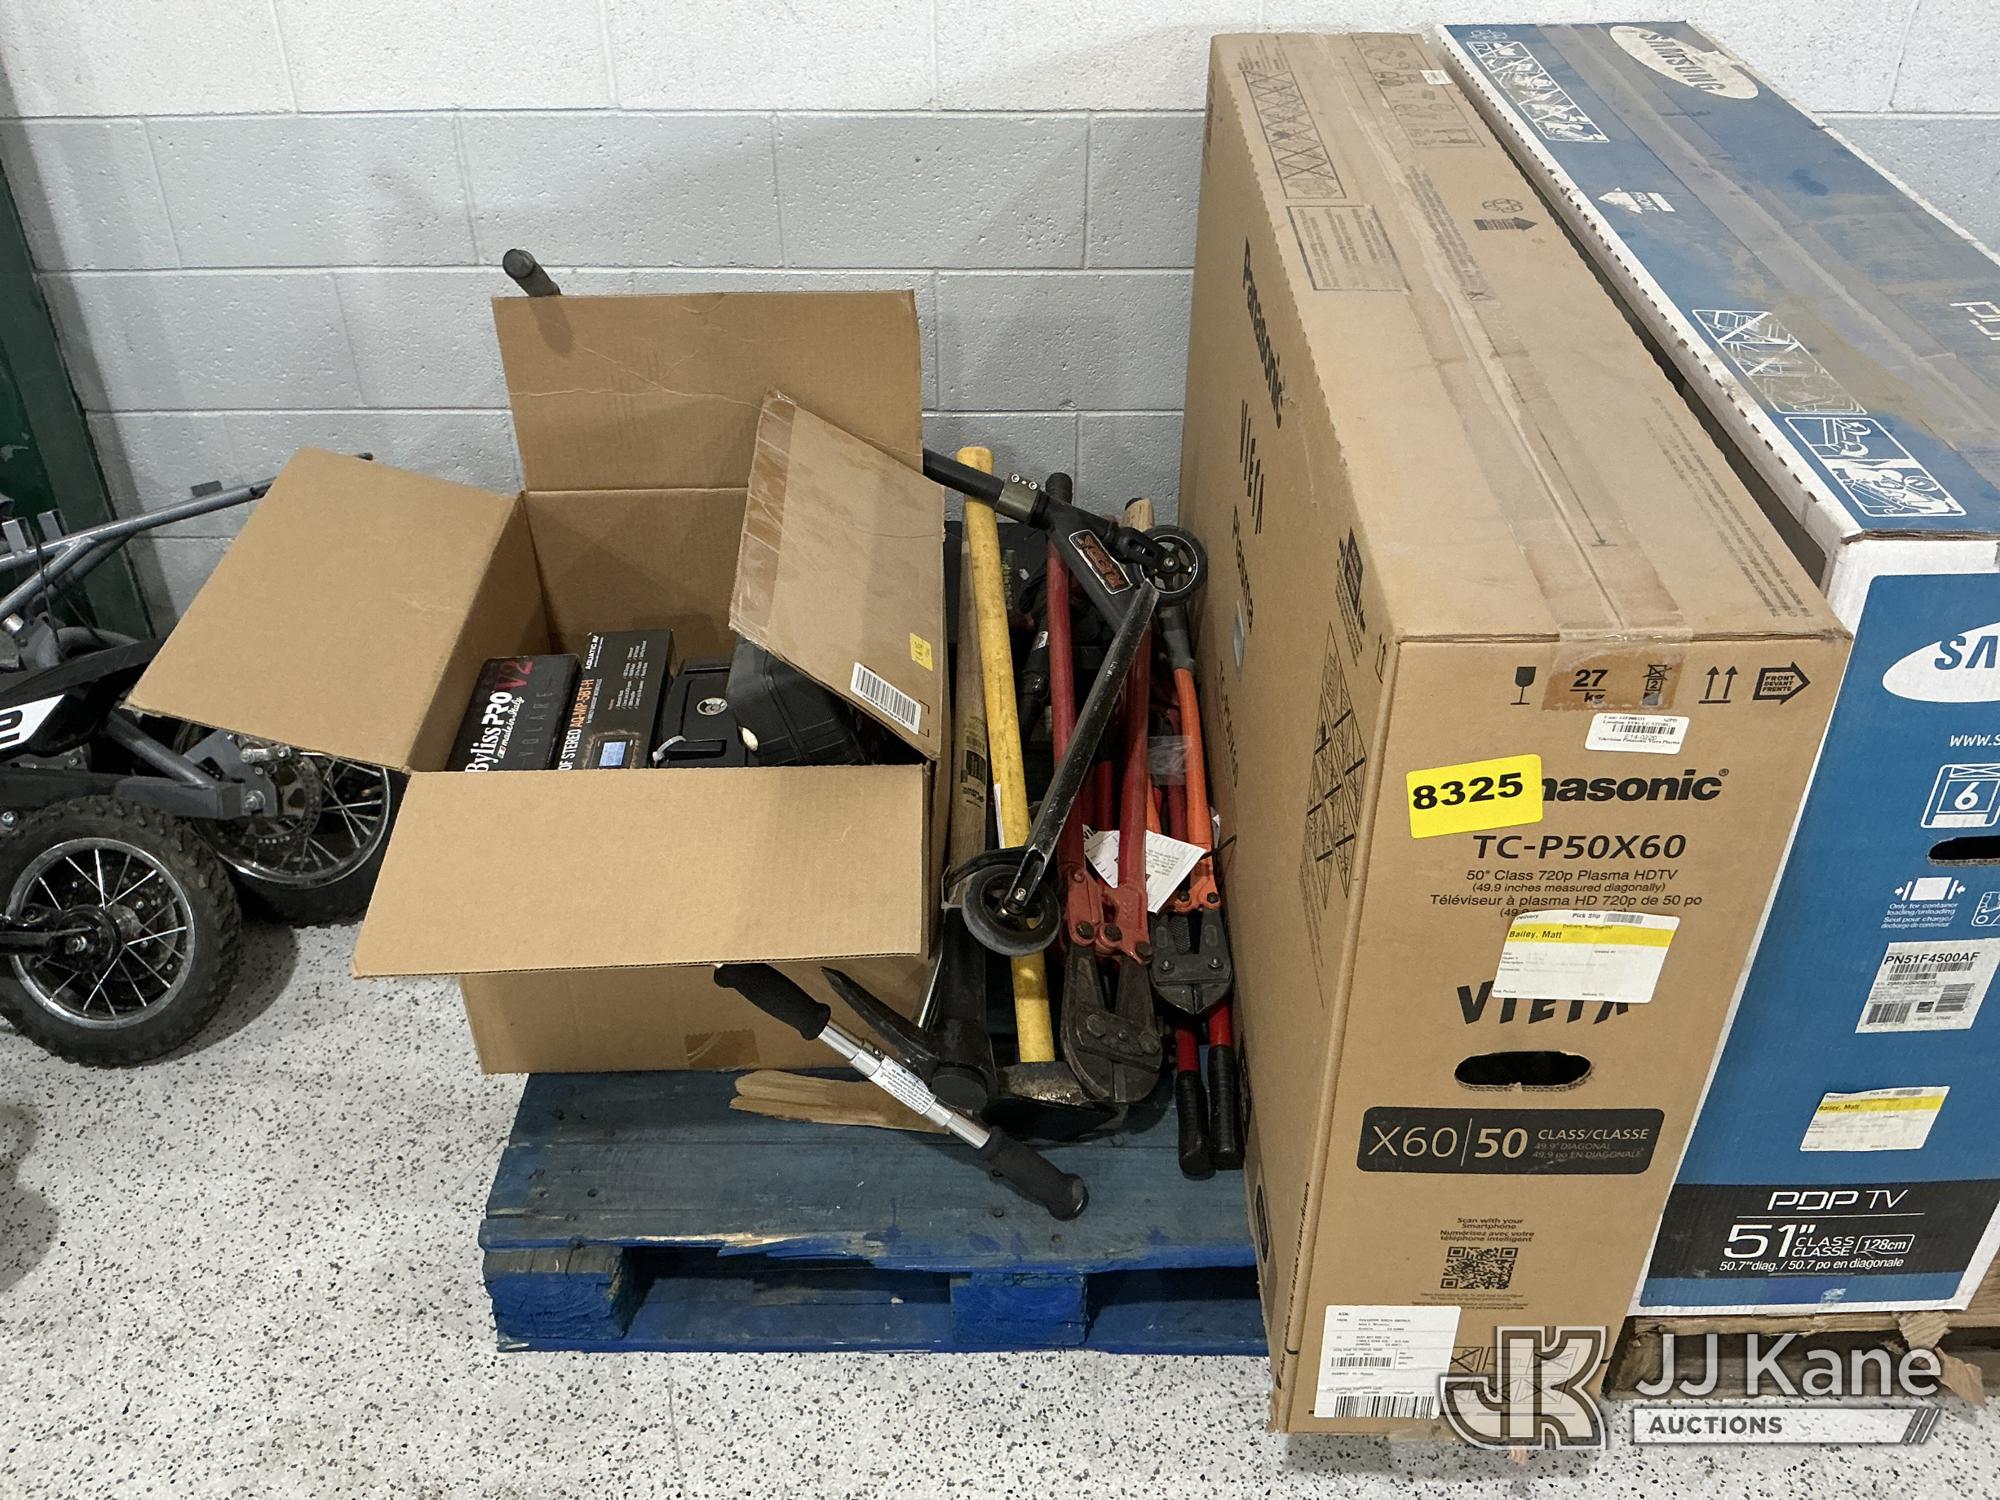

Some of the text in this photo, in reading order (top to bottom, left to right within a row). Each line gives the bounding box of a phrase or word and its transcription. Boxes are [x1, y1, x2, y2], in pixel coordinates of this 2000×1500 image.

[1639, 33, 1725, 91] SAMSUNG
[1243, 236, 1282, 429] Panasonic
[495, 655, 534, 690] V2
[1573, 668, 1609, 688] 27
[464, 691, 513, 773] Byliss PRO
[566, 728, 582, 758] STEREO
[1412, 772, 1524, 810] 8325
[1541, 769, 1723, 801] nasonic
[1954, 781, 1981, 810] 6
[1472, 834, 1687, 860] TC-P50X60
[1466, 870, 1679, 883] 50" Class 720p Plasma HDTV
[1472, 883, 1666, 894] (49.9 inches measured diagonally)
[1430, 894, 1703, 908] Téléviseur à plasma HD 720p de 50 po
[1509, 930, 1562, 939] Bailey, Matt
[1883, 951, 1981, 965] PN51F4500AF
[1367, 1125, 1650, 1159] X60 50 CLASS/CLASSE
[1560, 1142, 1611, 1150] DIAGONAL
[1585, 1151, 1641, 1159] DIAGONALE
[1767, 1189, 1909, 1211] PDP TV
[1723, 1224, 1856, 1259] 51" CLASS
[1791, 1238, 1908, 1257] CLASSE 128cm
[1788, 1259, 1814, 1270] 50.7
[1815, 1261, 1832, 1271] po
[1833, 1260, 1849, 1269] en
[1849, 1257, 1905, 1270] diagonale
